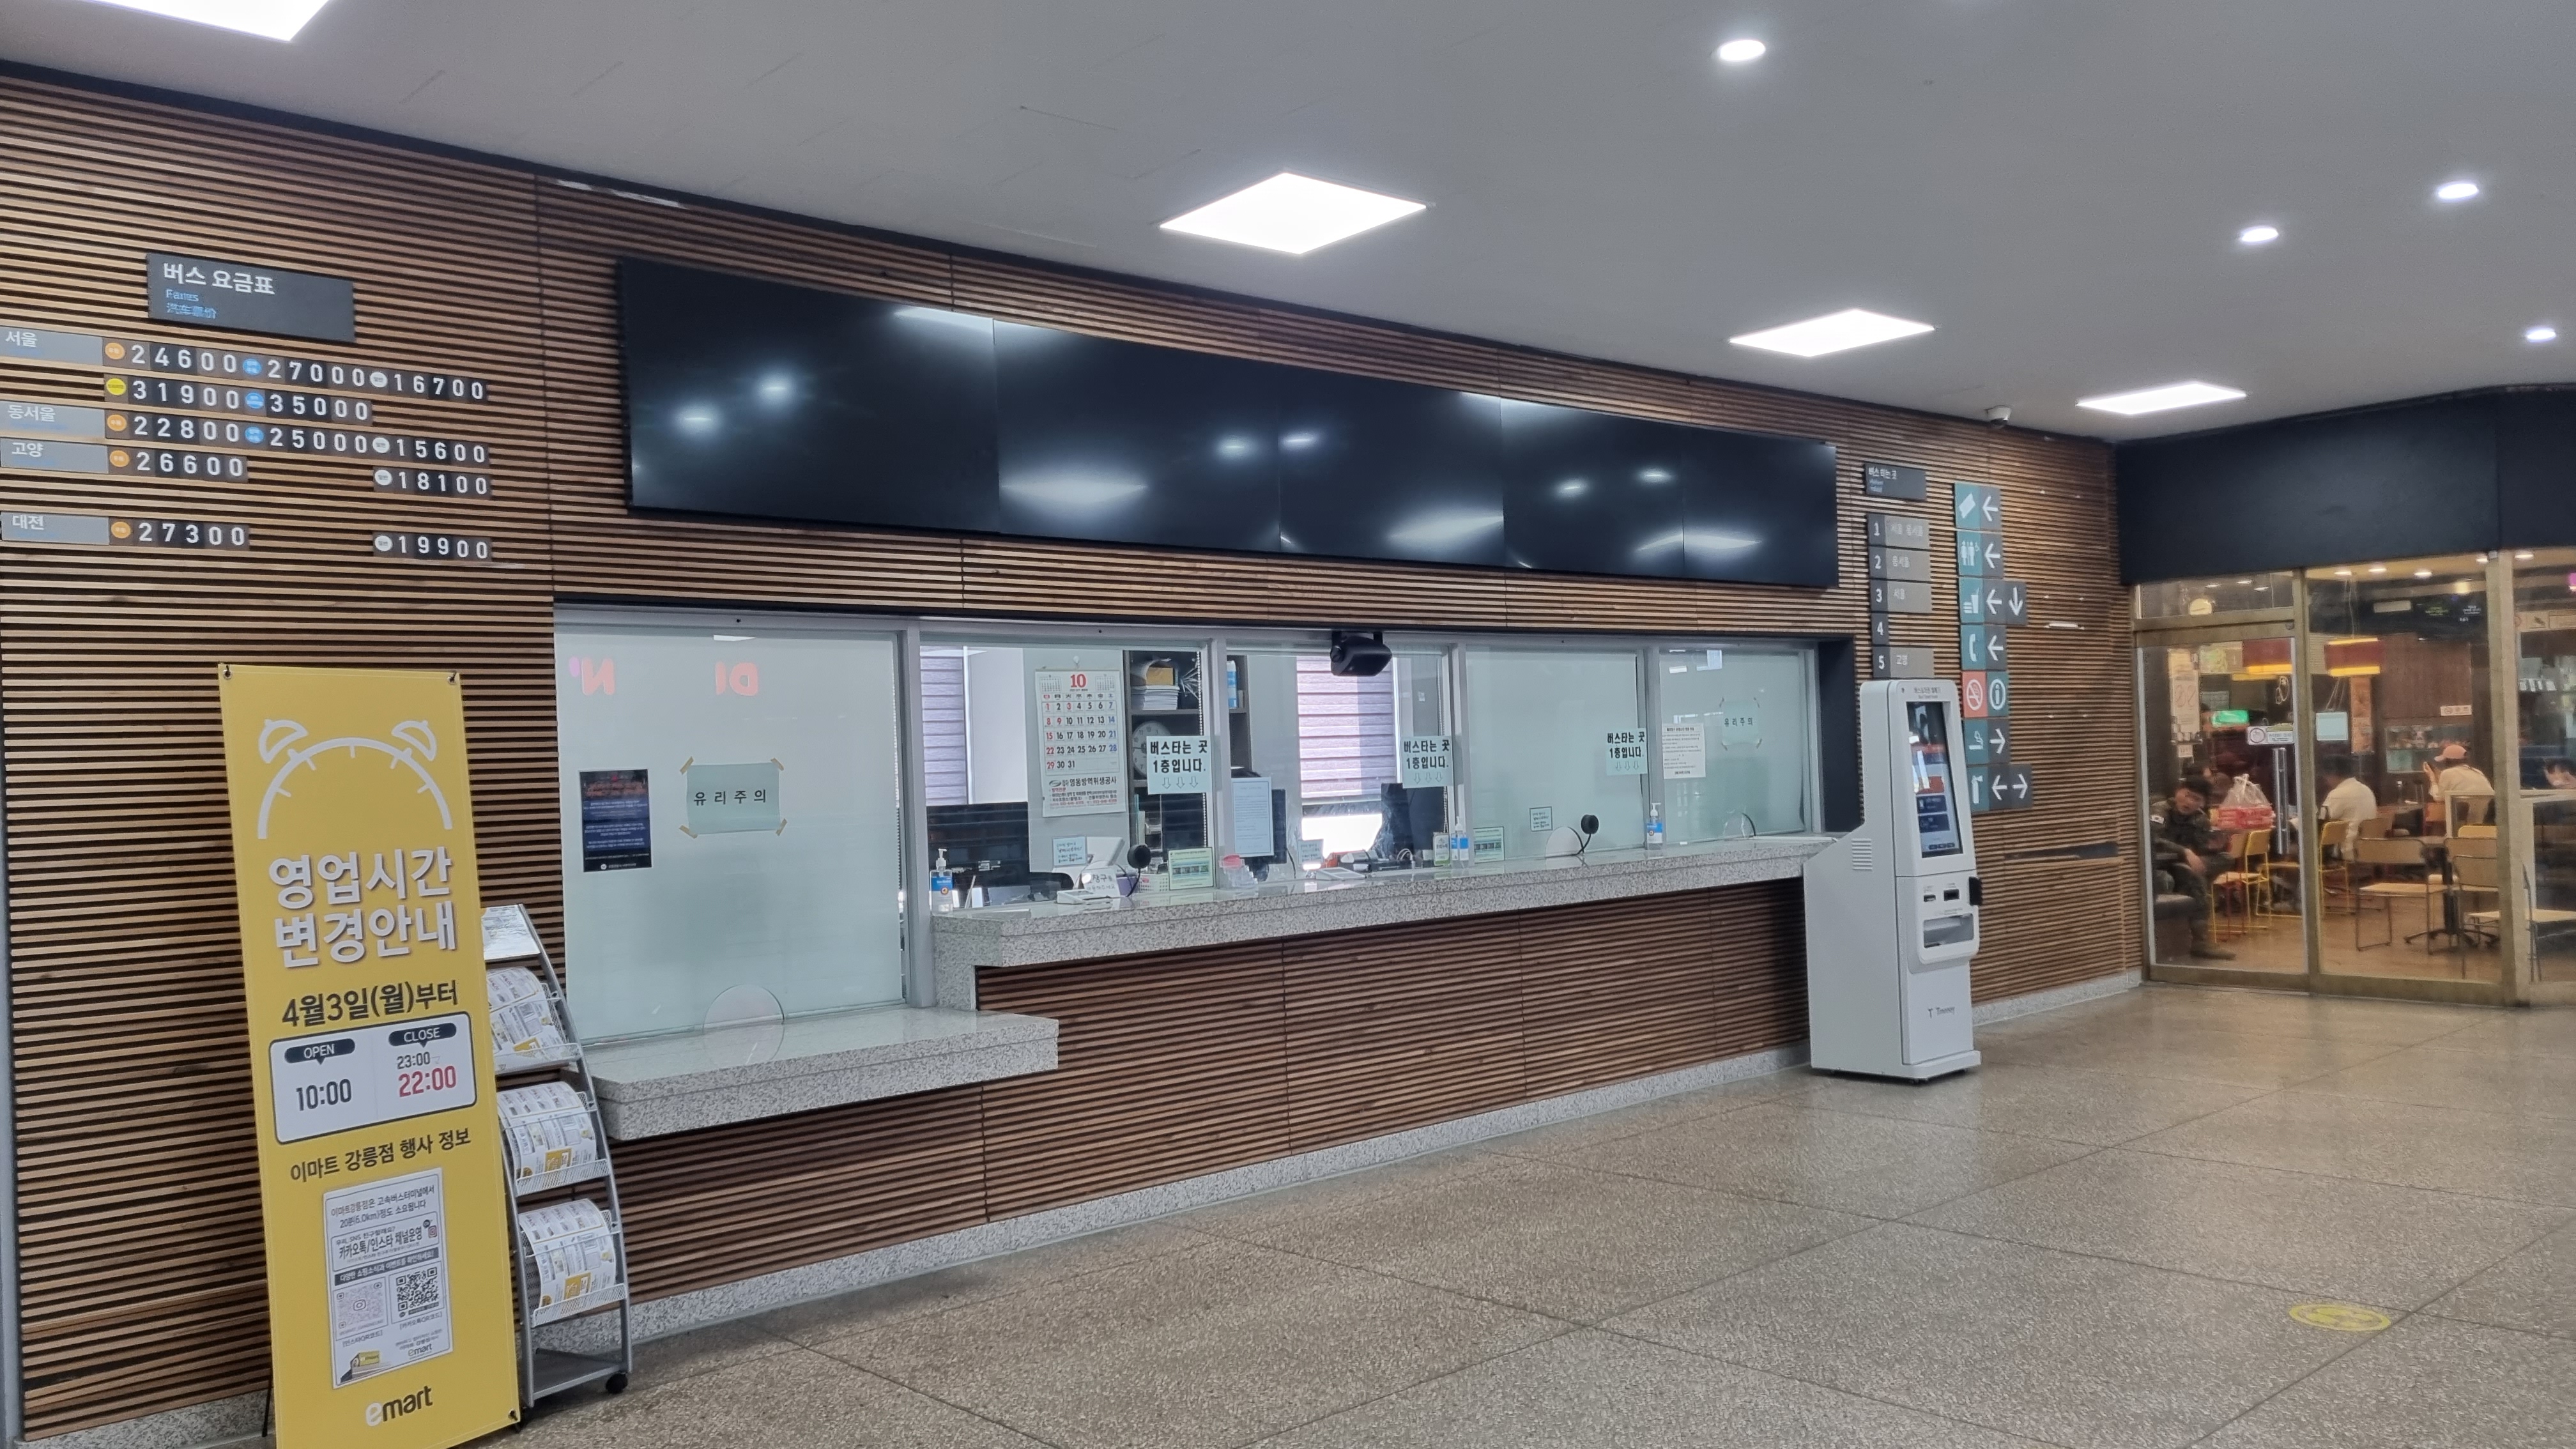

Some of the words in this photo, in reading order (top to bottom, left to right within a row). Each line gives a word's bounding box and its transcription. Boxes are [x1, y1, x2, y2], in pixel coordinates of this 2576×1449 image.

[163, 263, 206, 286] 버스
[211, 270, 275, 295] 요금표
[5, 330, 38, 347] 서울
[132, 344, 237, 373] 24600
[267, 360, 364, 387] 27000
[394, 374, 483, 400] 16700
[133, 380, 239, 409] 31900
[270, 394, 368, 420] 35000
[8, 404, 56, 422] 동서울
[134, 416, 240, 442] 22800
[270, 427, 367, 454] 25000
[396, 439, 486, 464] 15600
[12, 442, 43, 457] 고양
[136, 452, 242, 477] 26600
[399, 471, 487, 495] 18100
[12, 515, 45, 530] 대전
[1874, 522, 1880, 536] 1
[138, 523, 245, 546] 27300
[399, 535, 487, 560] 19900
[1874, 555, 1882, 569] 2
[1876, 588, 1882, 602] 3
[1876, 622, 1884, 636] 4
[1878, 655, 1885, 670] 5
[1070, 673, 1087, 688] 10
[1607, 732, 1634, 744] 버스타는
[1638, 731, 1645, 743] 곳
[1150, 740, 1192, 755] 버스타는
[1199, 740, 1208, 753] 곳
[1404, 740, 1437, 753] 버스타는
[1441, 739, 1450, 751] 곳
[1609, 746, 1644, 759] 1층입니다.
[1153, 758, 1206, 773] 1층입니다.
[1406, 755, 1449, 769] 1층입니다.
[269, 846, 453, 909] 영업시간
[275, 900, 456, 968] 변경안내
[282, 979, 458, 1027] 4월3일(월)부터
[403, 1027, 441, 1043] CLOSE
[303, 1043, 335, 1059] OPEN
[396, 1052, 431, 1070] 23:00
[398, 1066, 456, 1097] 22:00
[296, 1078, 351, 1111] 10:00
[291, 1155, 340, 1182] 이마트
[345, 1142, 394, 1171] 강릉점
[400, 1134, 433, 1159] 행사
[439, 1128, 471, 1151] 정보
[349, 1234, 361, 1243] SNS
[408, 1344, 432, 1356] emart
[365, 1385, 433, 1427] emart
